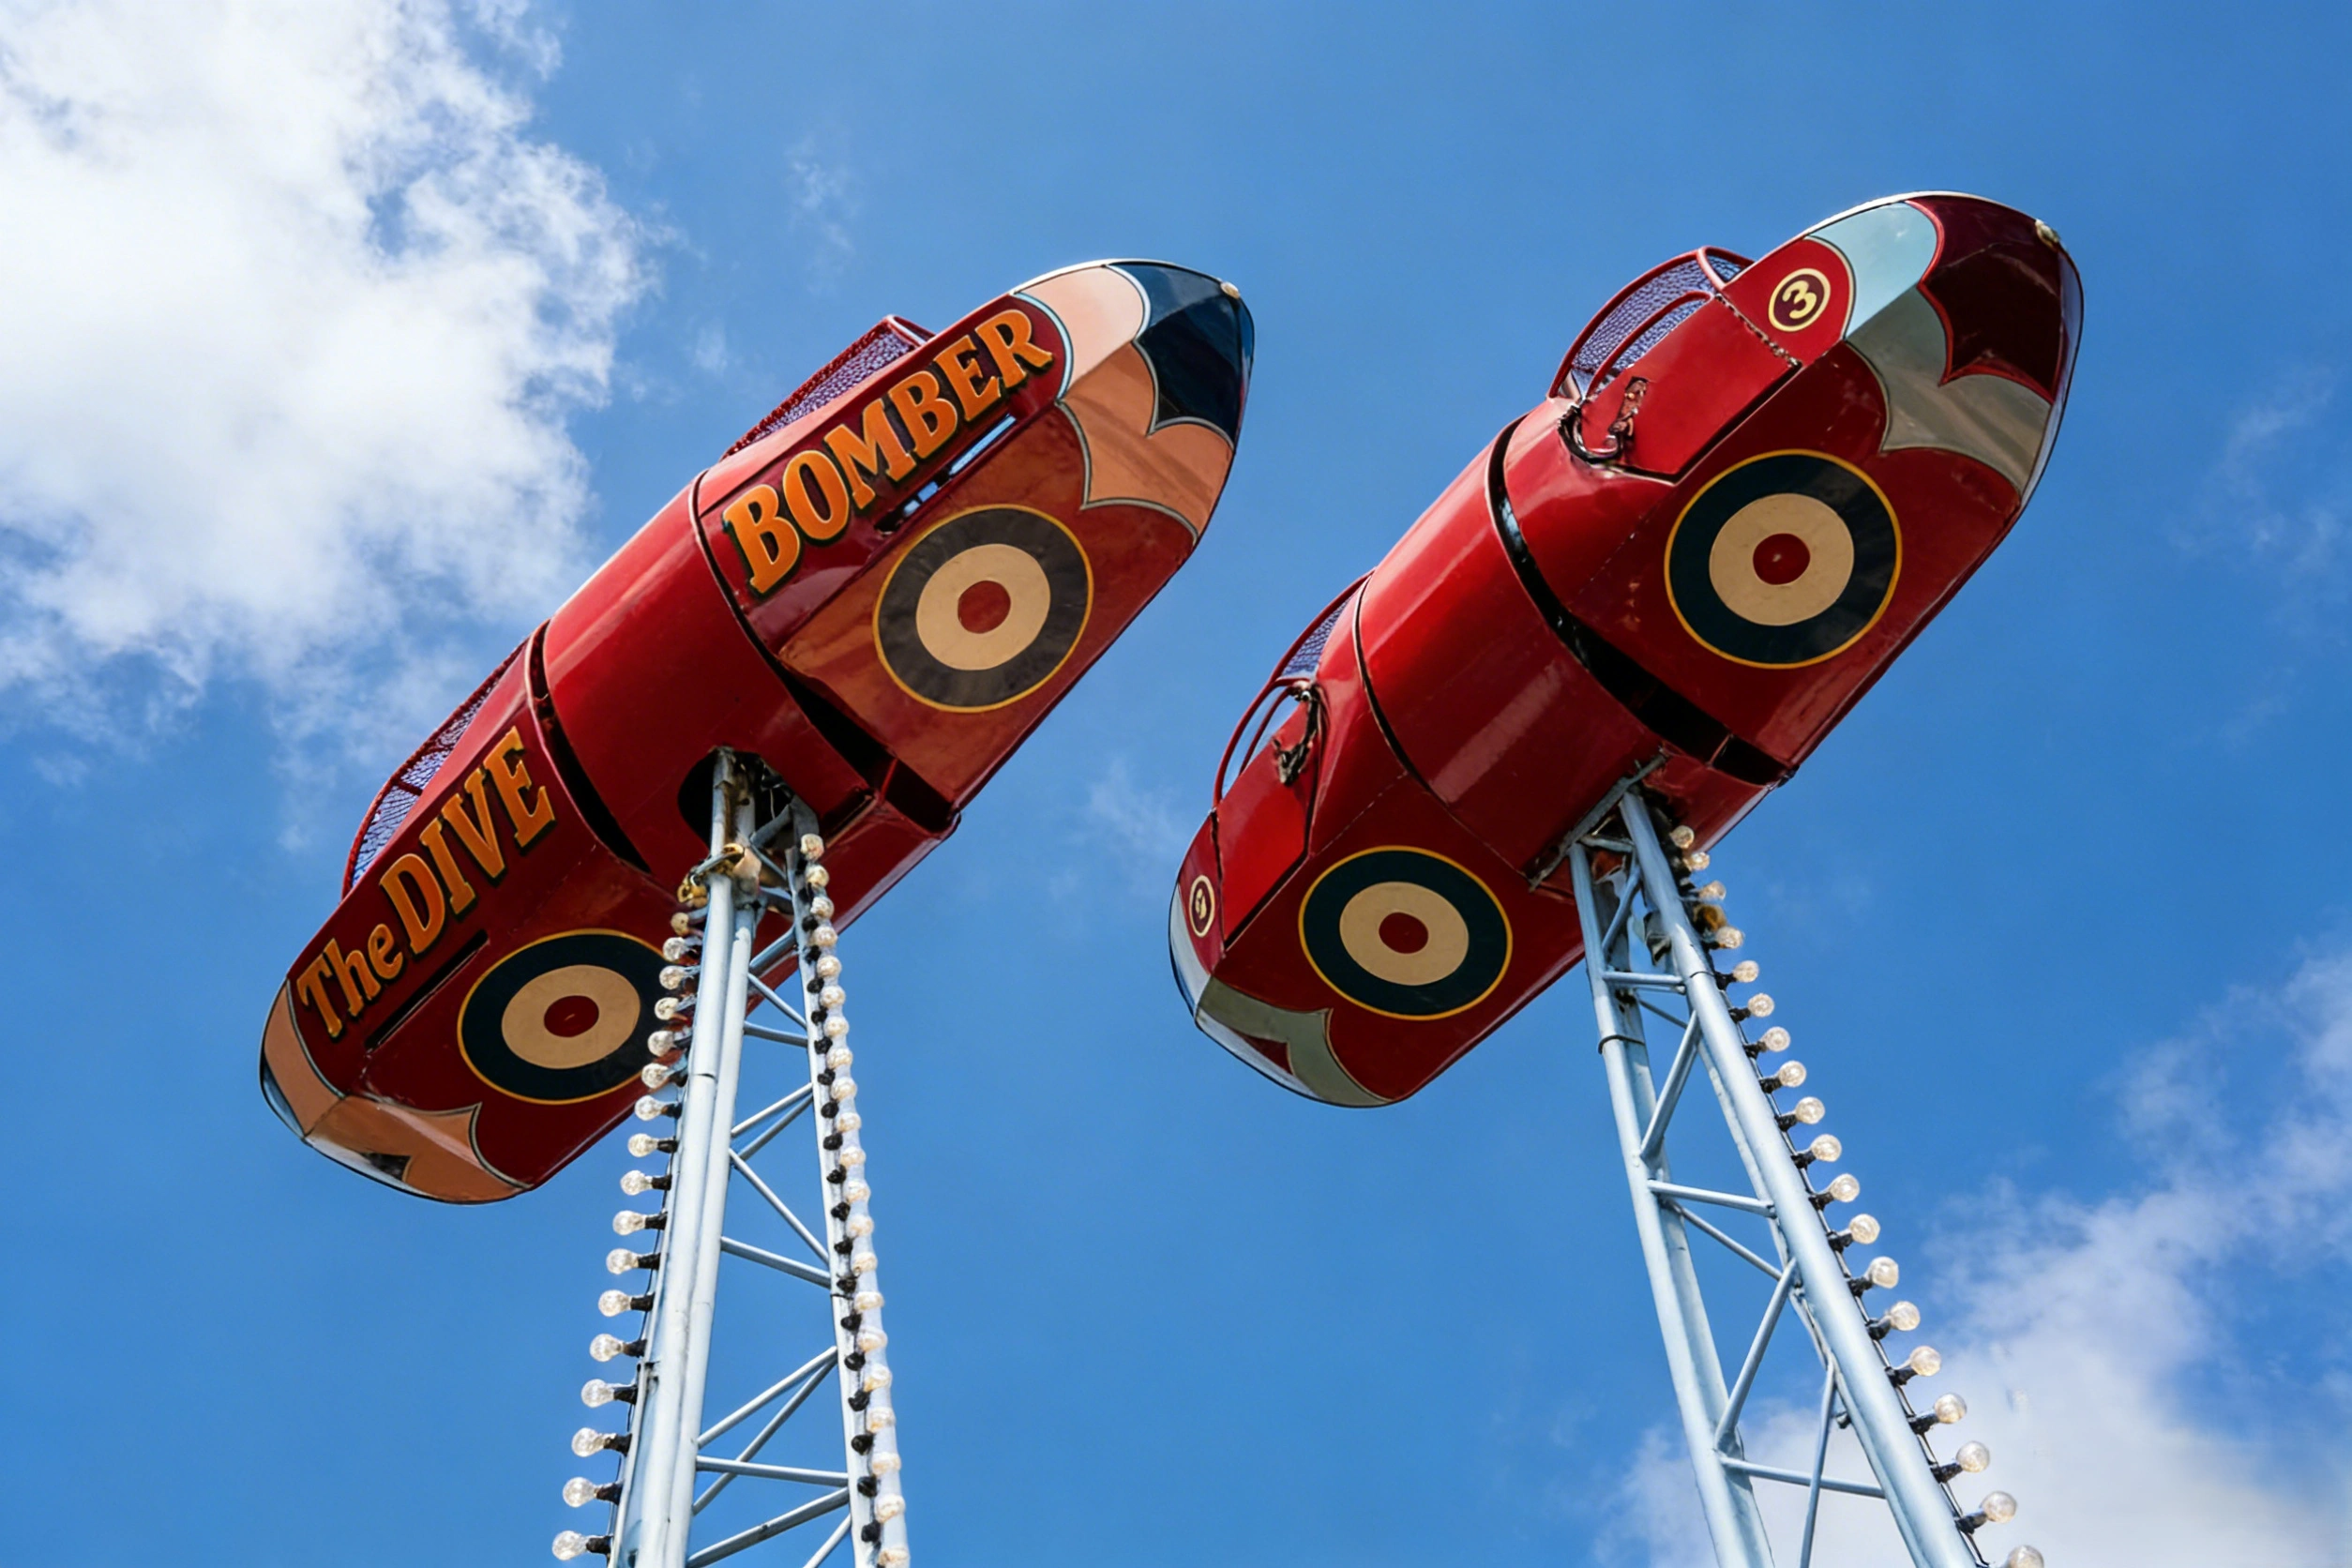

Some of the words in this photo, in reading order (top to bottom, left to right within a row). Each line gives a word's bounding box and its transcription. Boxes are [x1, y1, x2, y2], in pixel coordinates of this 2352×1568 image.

[1782, 280, 1817, 319] 3
[296, 924, 403, 1037] The
[379, 726, 556, 955] DIVE
[722, 309, 1053, 595] BOMBER
